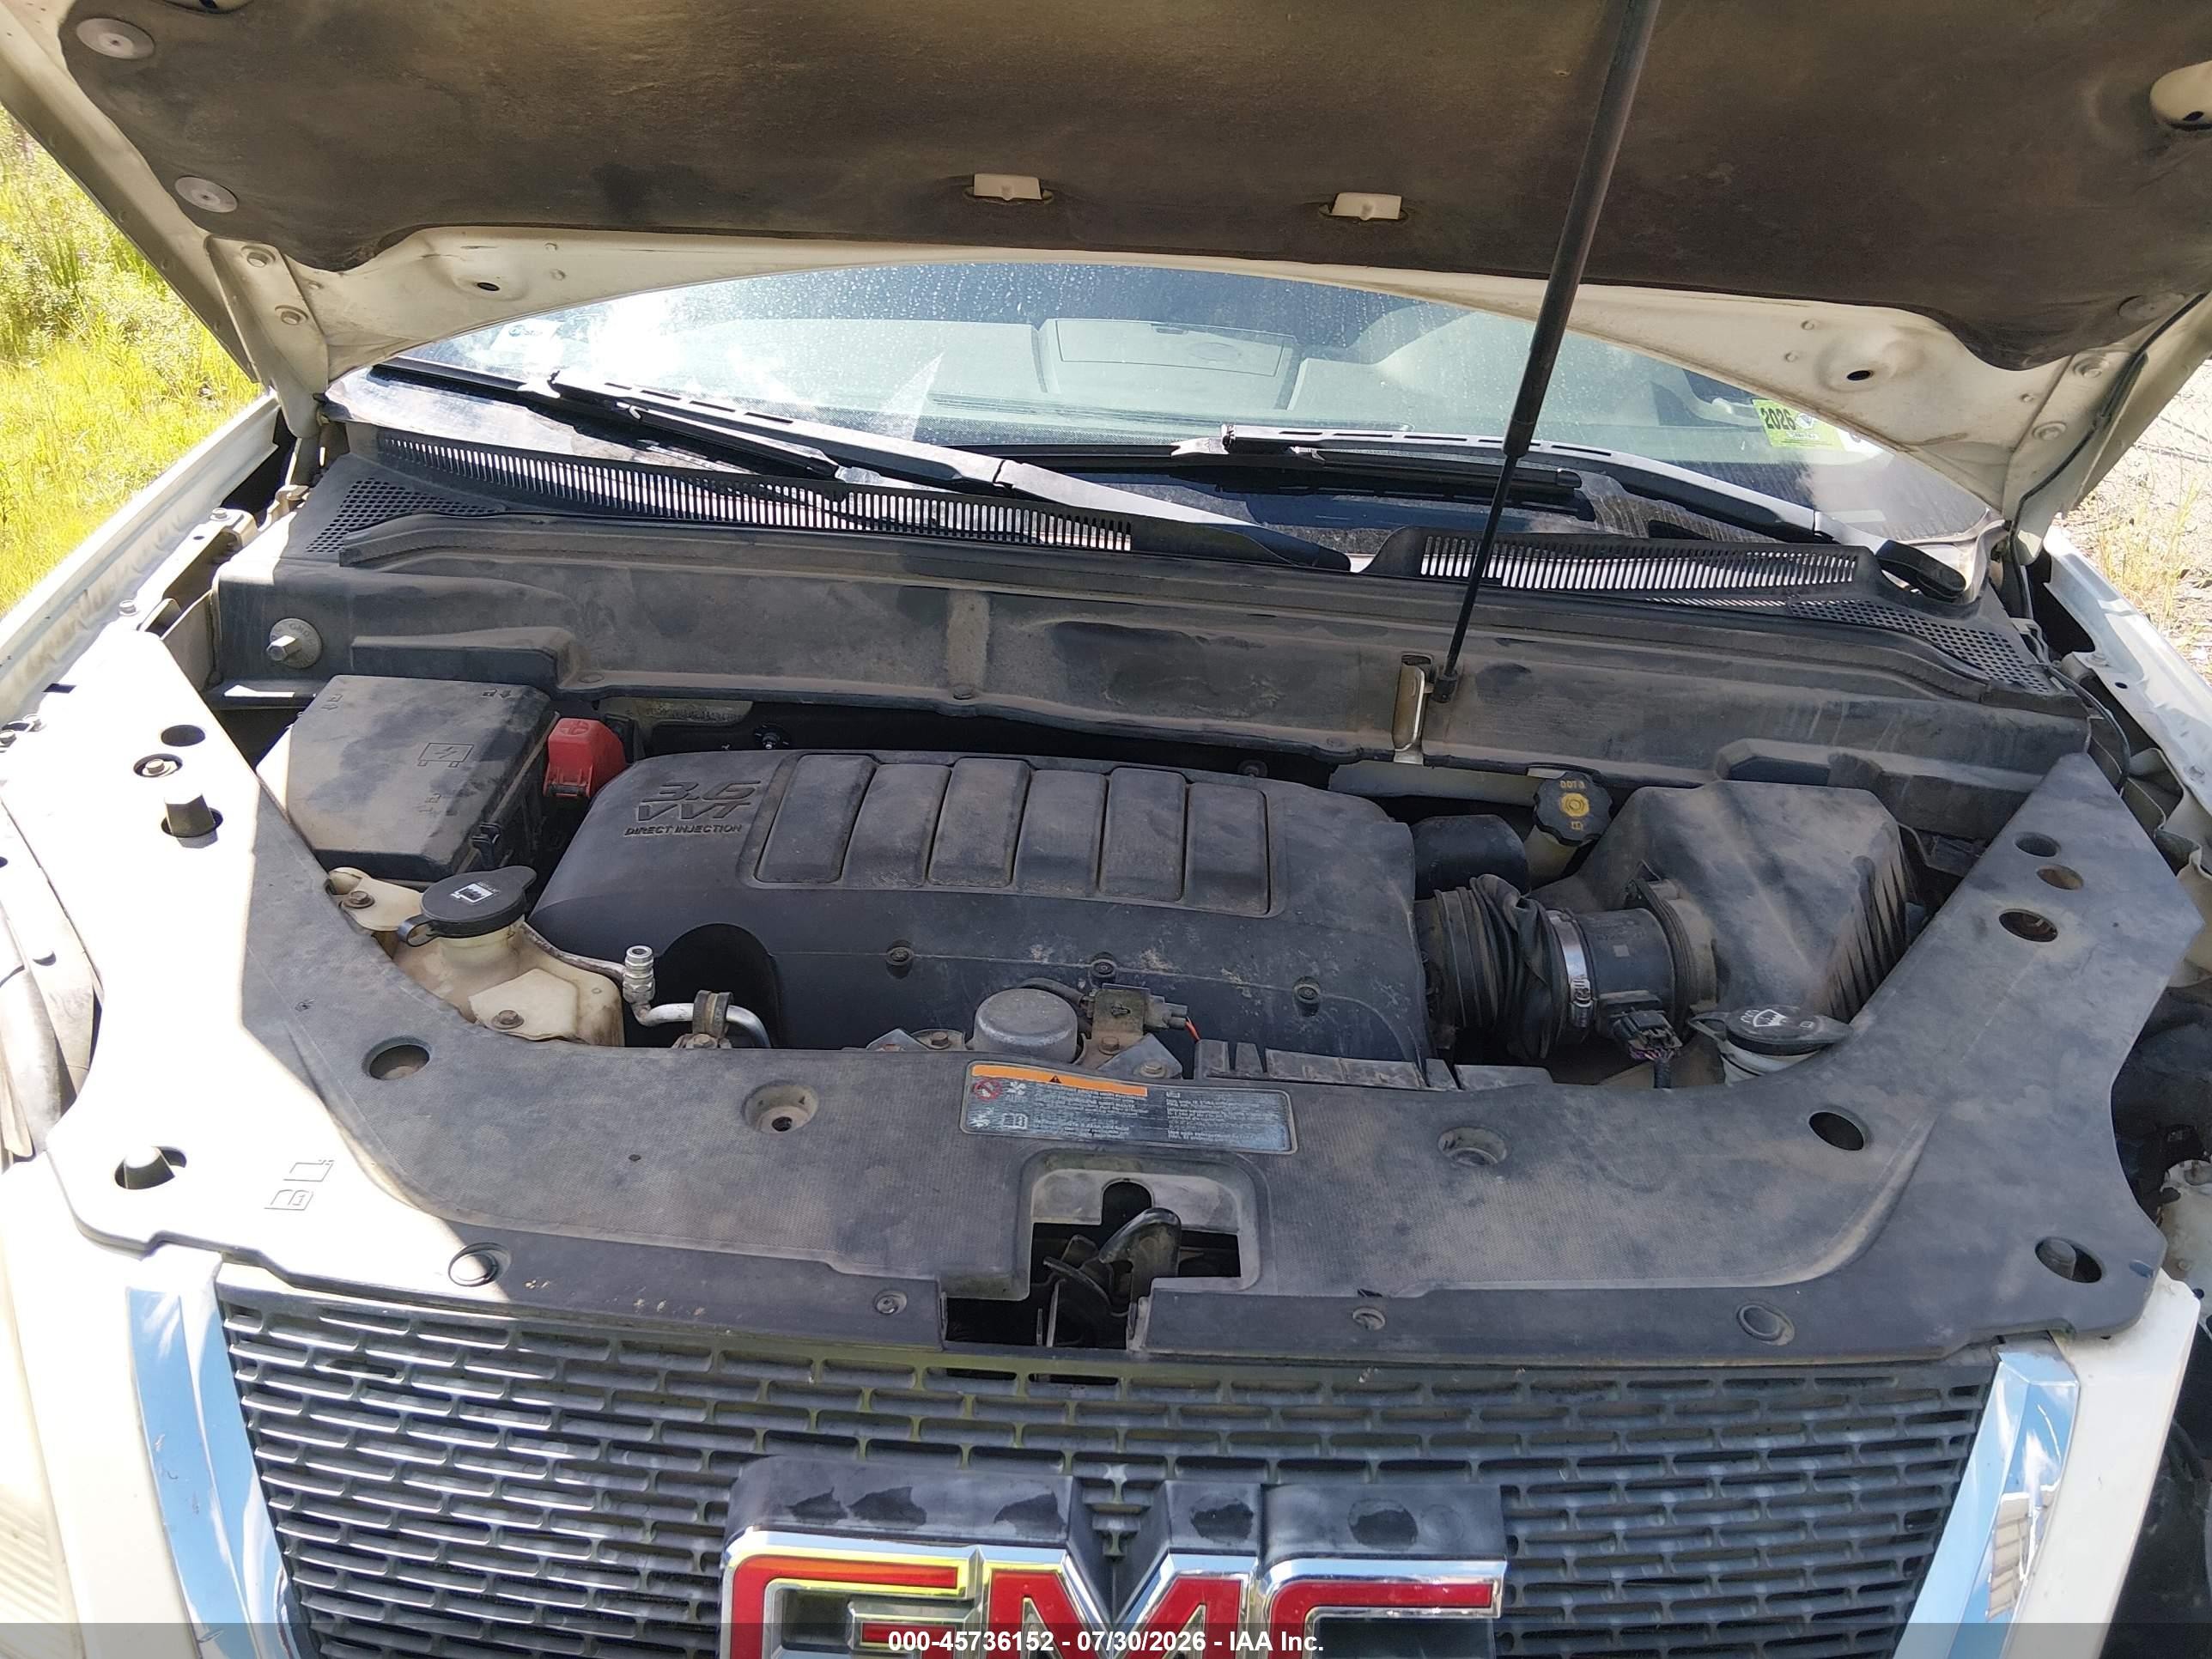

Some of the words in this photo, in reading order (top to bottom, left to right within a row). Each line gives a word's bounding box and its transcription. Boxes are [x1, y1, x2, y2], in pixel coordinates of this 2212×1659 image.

[1760, 407, 1796, 430] 2026
[641, 781, 762, 804] 3.6
[636, 801, 751, 822] VVT
[624, 825, 674, 836] DIRECT
[675, 823, 743, 835] INJECTION
